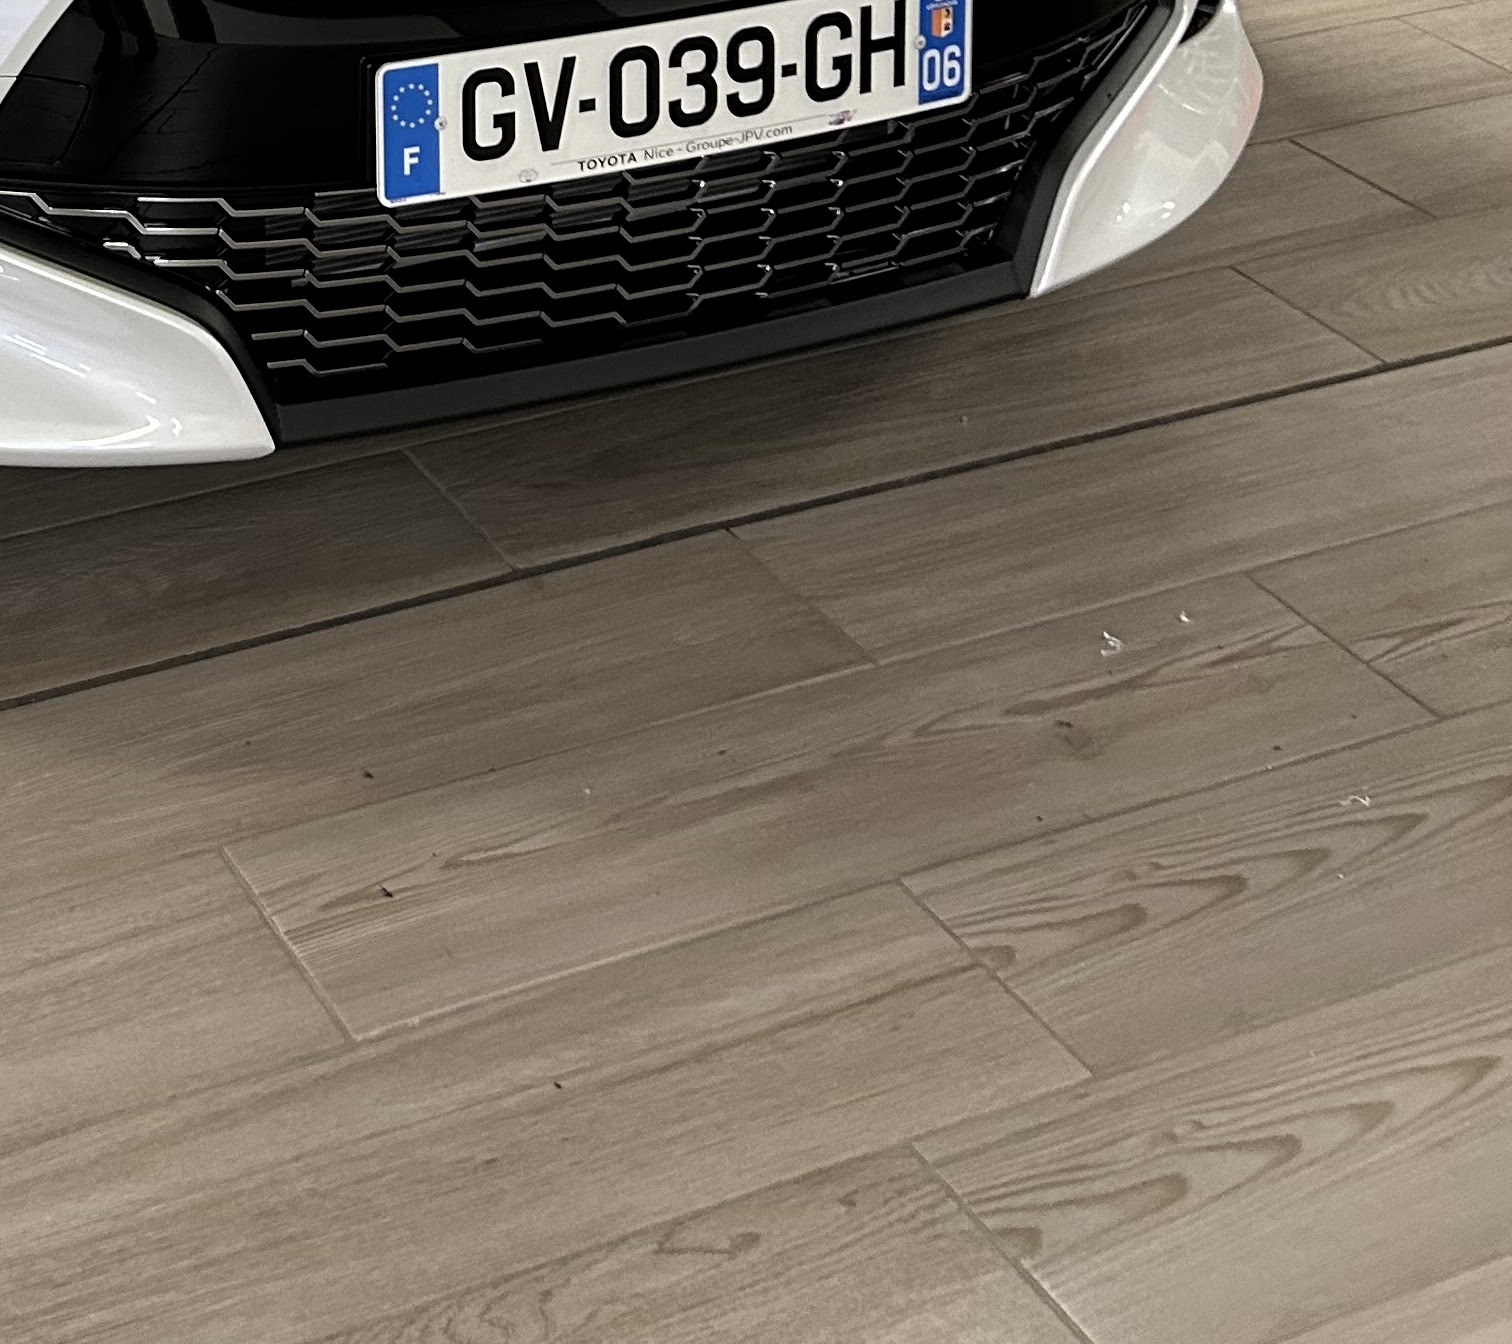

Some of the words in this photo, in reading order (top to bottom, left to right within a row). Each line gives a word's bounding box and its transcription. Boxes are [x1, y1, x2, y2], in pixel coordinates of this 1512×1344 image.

[403, 145, 421, 176] F
[922, 44, 961, 92] 06
[577, 152, 637, 173] TOYOTA
[644, 149, 674, 161] Nice
